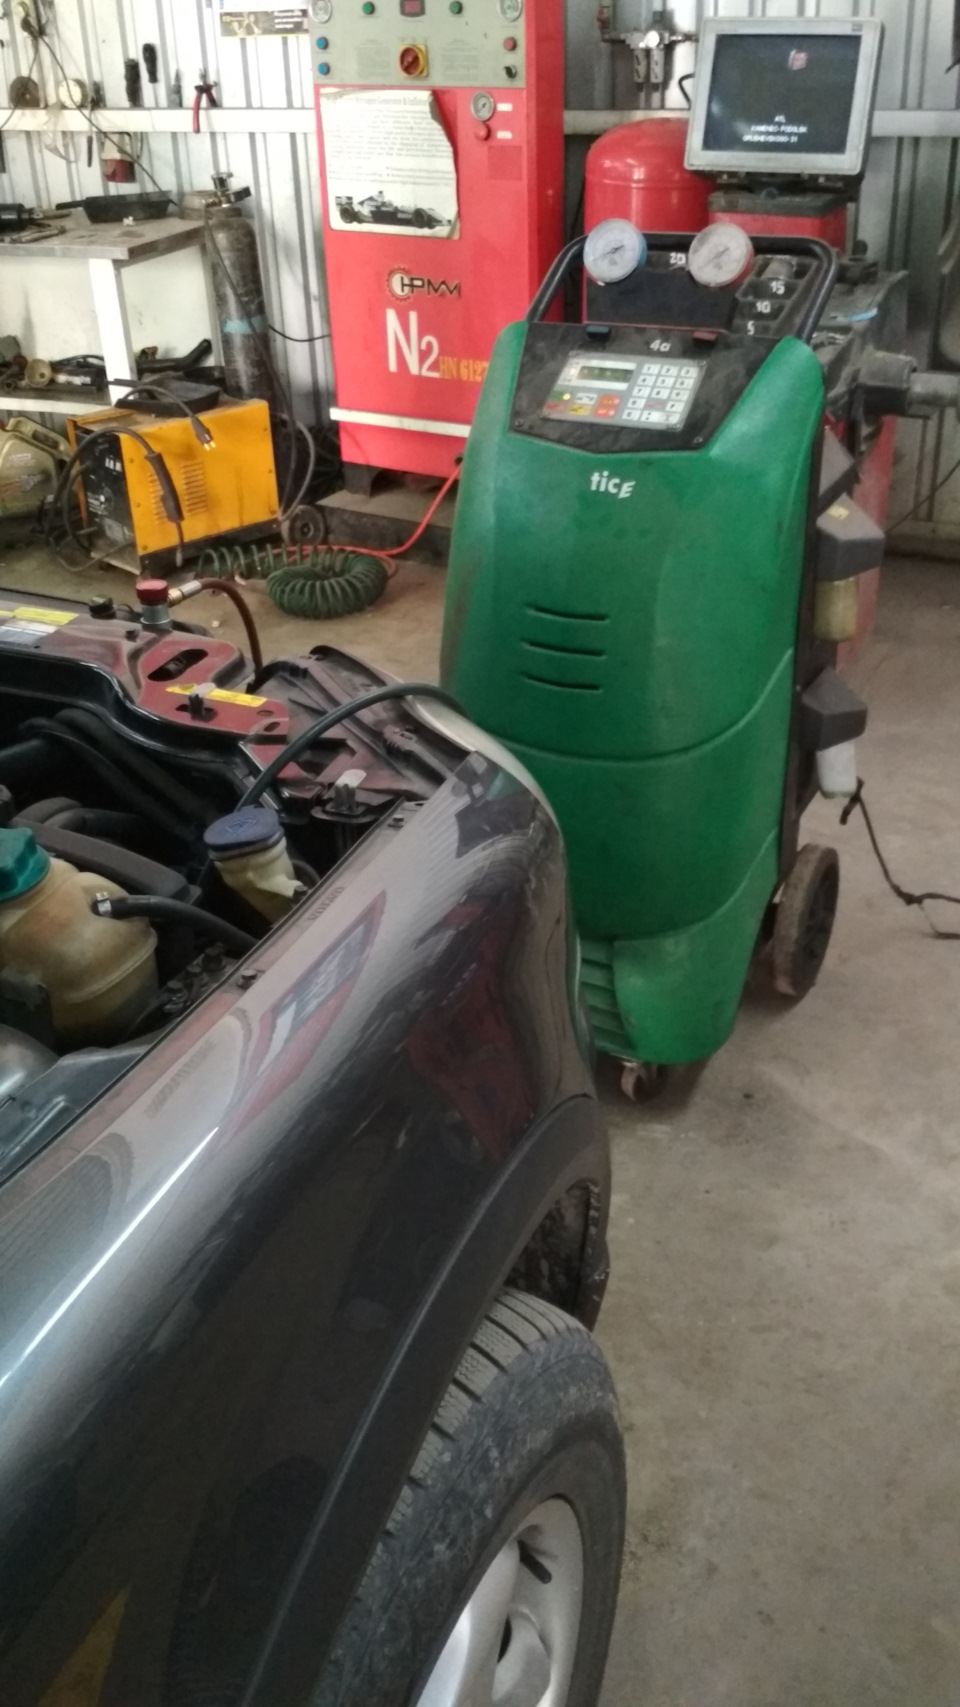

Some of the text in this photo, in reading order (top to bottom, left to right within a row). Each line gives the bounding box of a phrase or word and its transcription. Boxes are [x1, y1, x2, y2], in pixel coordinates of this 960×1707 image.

[770, 281, 786, 295] 15
[755, 301, 772, 314] 10
[746, 320, 756, 336] 5
